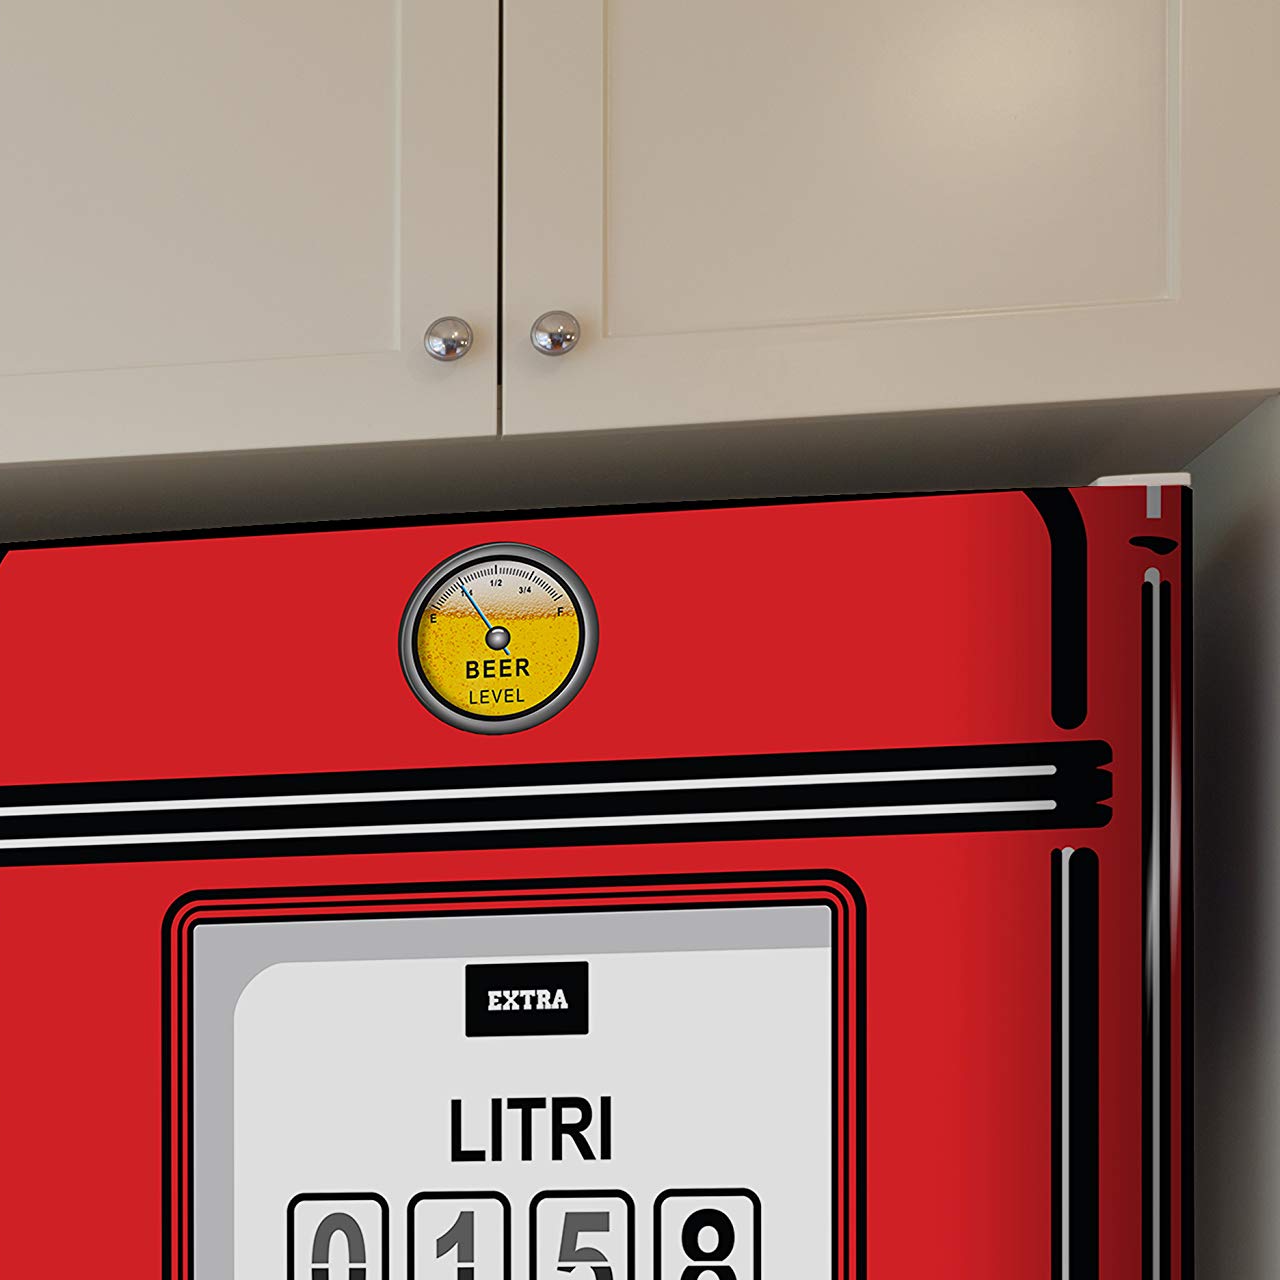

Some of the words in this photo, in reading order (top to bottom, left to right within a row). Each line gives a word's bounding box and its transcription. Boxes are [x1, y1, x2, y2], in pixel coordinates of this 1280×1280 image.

[490, 579, 503, 587] 1/2
[460, 589, 473, 597] 14
[518, 586, 532, 594] 3/4
[557, 606, 564, 617] F
[430, 613, 437, 623] E
[466, 658, 530, 679] BEER
[469, 688, 525, 705] LEVEL
[487, 988, 569, 1011] EXTRA
[450, 1095, 612, 1163] LITRI
